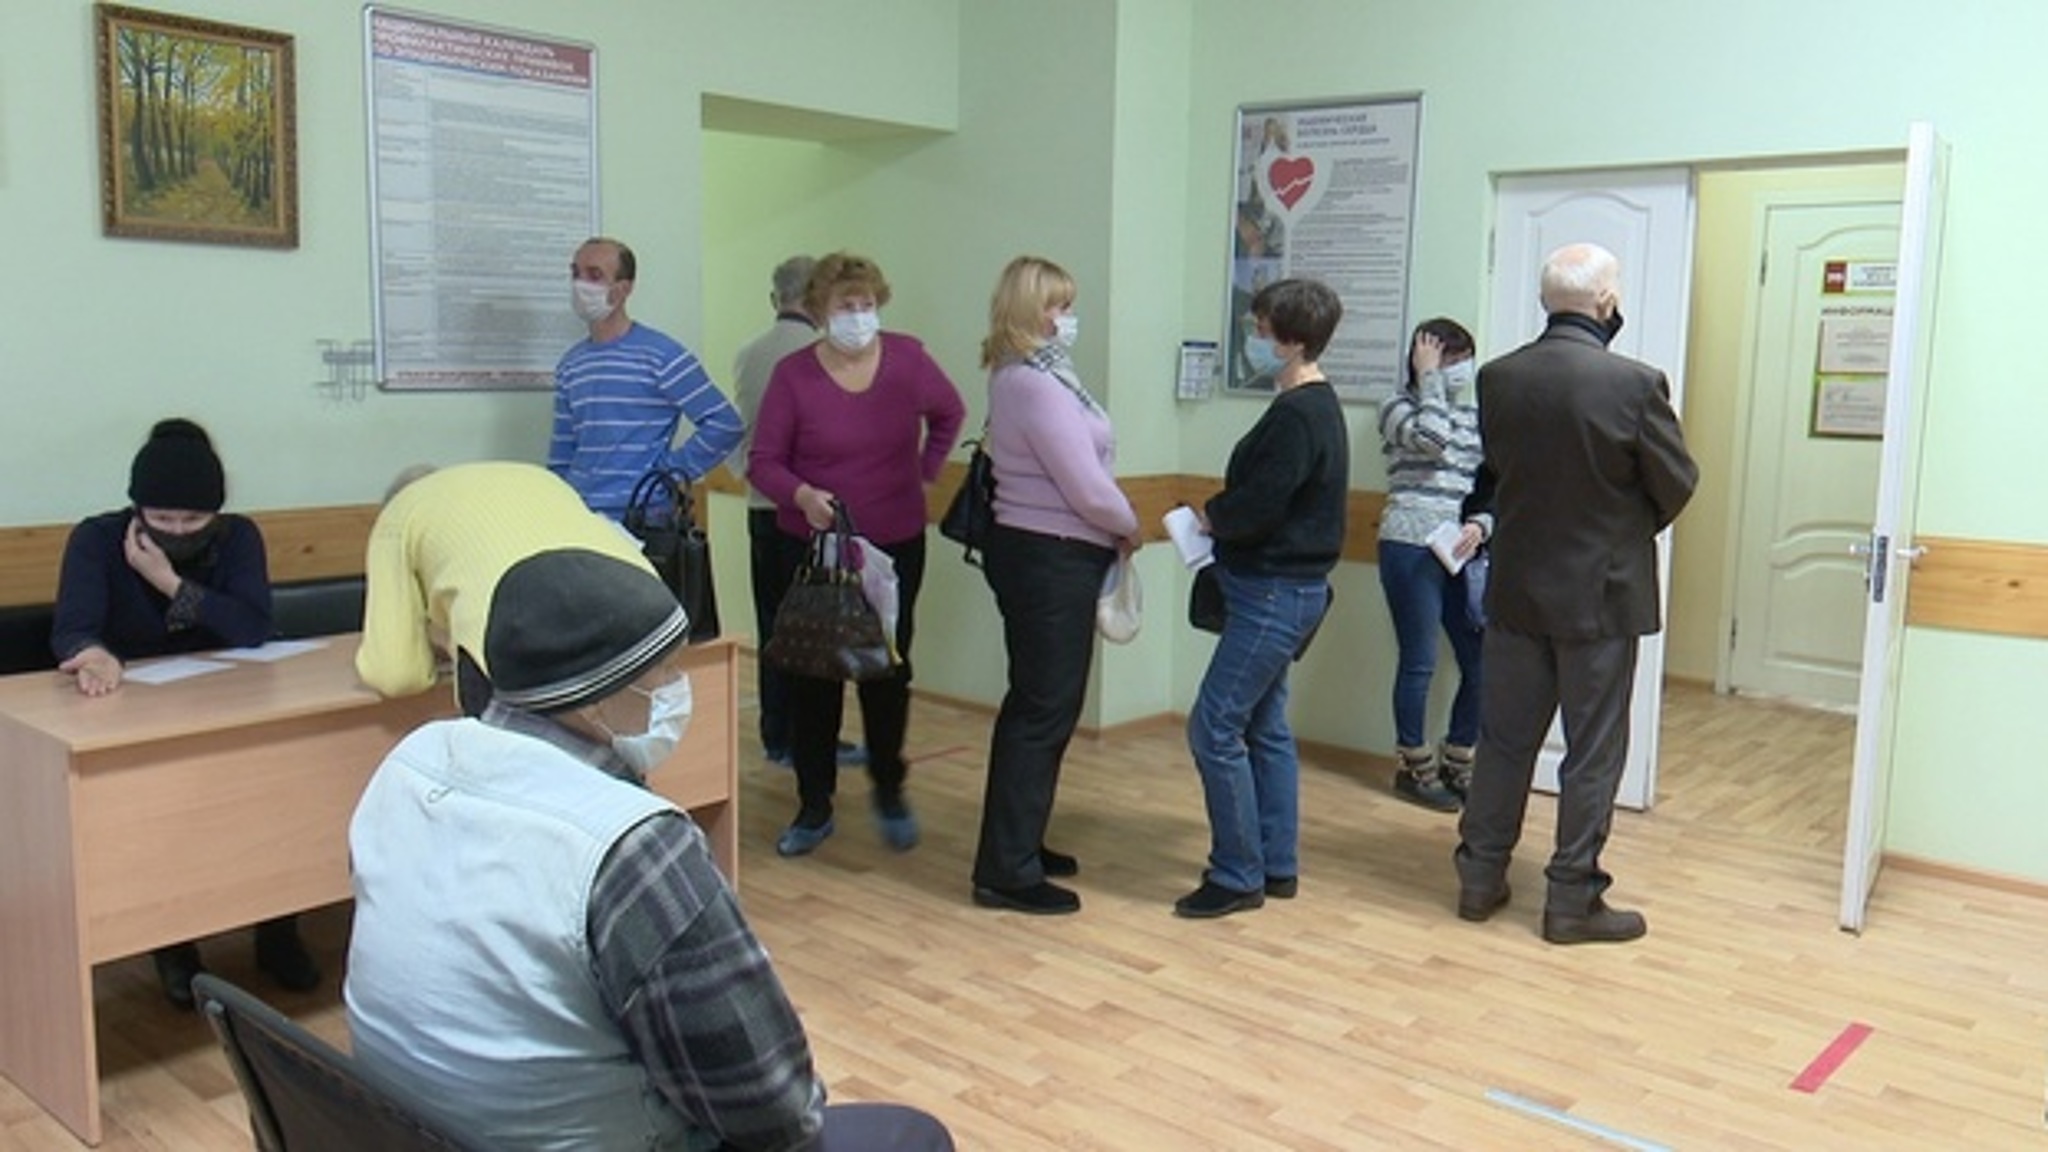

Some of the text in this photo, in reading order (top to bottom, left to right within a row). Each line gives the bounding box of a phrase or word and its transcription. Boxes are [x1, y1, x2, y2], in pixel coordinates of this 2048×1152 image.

[374, 31, 574, 72] ПРОФИЛАКТИЧЕСКИХ ПРИВИВОК
[484, 34, 555, 58] КАЛЕНДАРЬ
[509, 64, 587, 84] ПОКАЗАНИЯМ
[1296, 113, 1367, 126] ИШЕМИЧЕСКАЯ
[1296, 123, 1377, 139] БОЛЕЗНЬ СЕРДЦА
